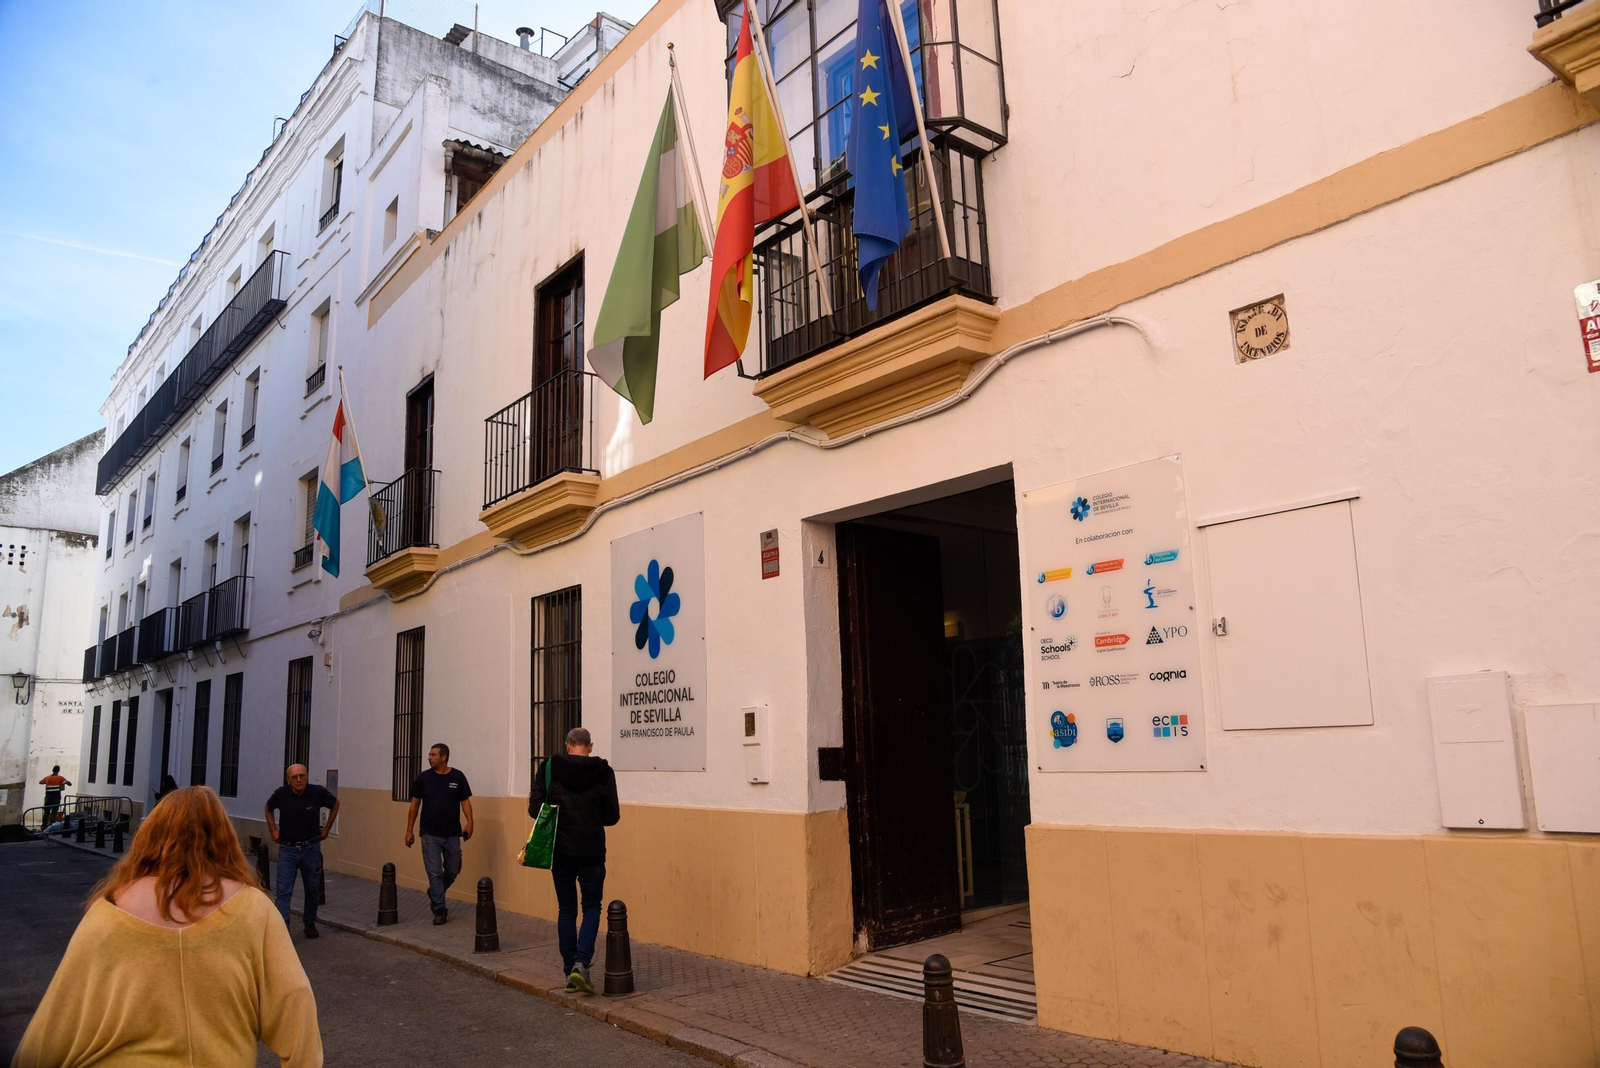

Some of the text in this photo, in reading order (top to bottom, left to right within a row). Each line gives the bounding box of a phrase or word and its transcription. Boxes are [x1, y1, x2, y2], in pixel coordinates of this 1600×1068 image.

[1255, 325, 1268, 338] DE
[1092, 492, 1112, 500] COLEGIO
[1092, 494, 1130, 506] INTERNACIONAL
[1100, 502, 1119, 510] SEVILLA
[1084, 530, 1120, 542] colaboración
[818, 550, 824, 564] 4
[1162, 626, 1188, 638] YPO
[1096, 636, 1126, 645] Cambridge
[1041, 644, 1071, 654] Schools
[636, 670, 676, 687] COLEGIO
[1096, 674, 1120, 686] ROSS
[1149, 670, 1187, 682] cognia
[620, 686, 694, 706] INTERNACIONAL
[630, 707, 682, 724] DE SEVILLA
[620, 726, 694, 738] SAN FRANCISCO DE PAULA
[1055, 725, 1076, 737] asibi
